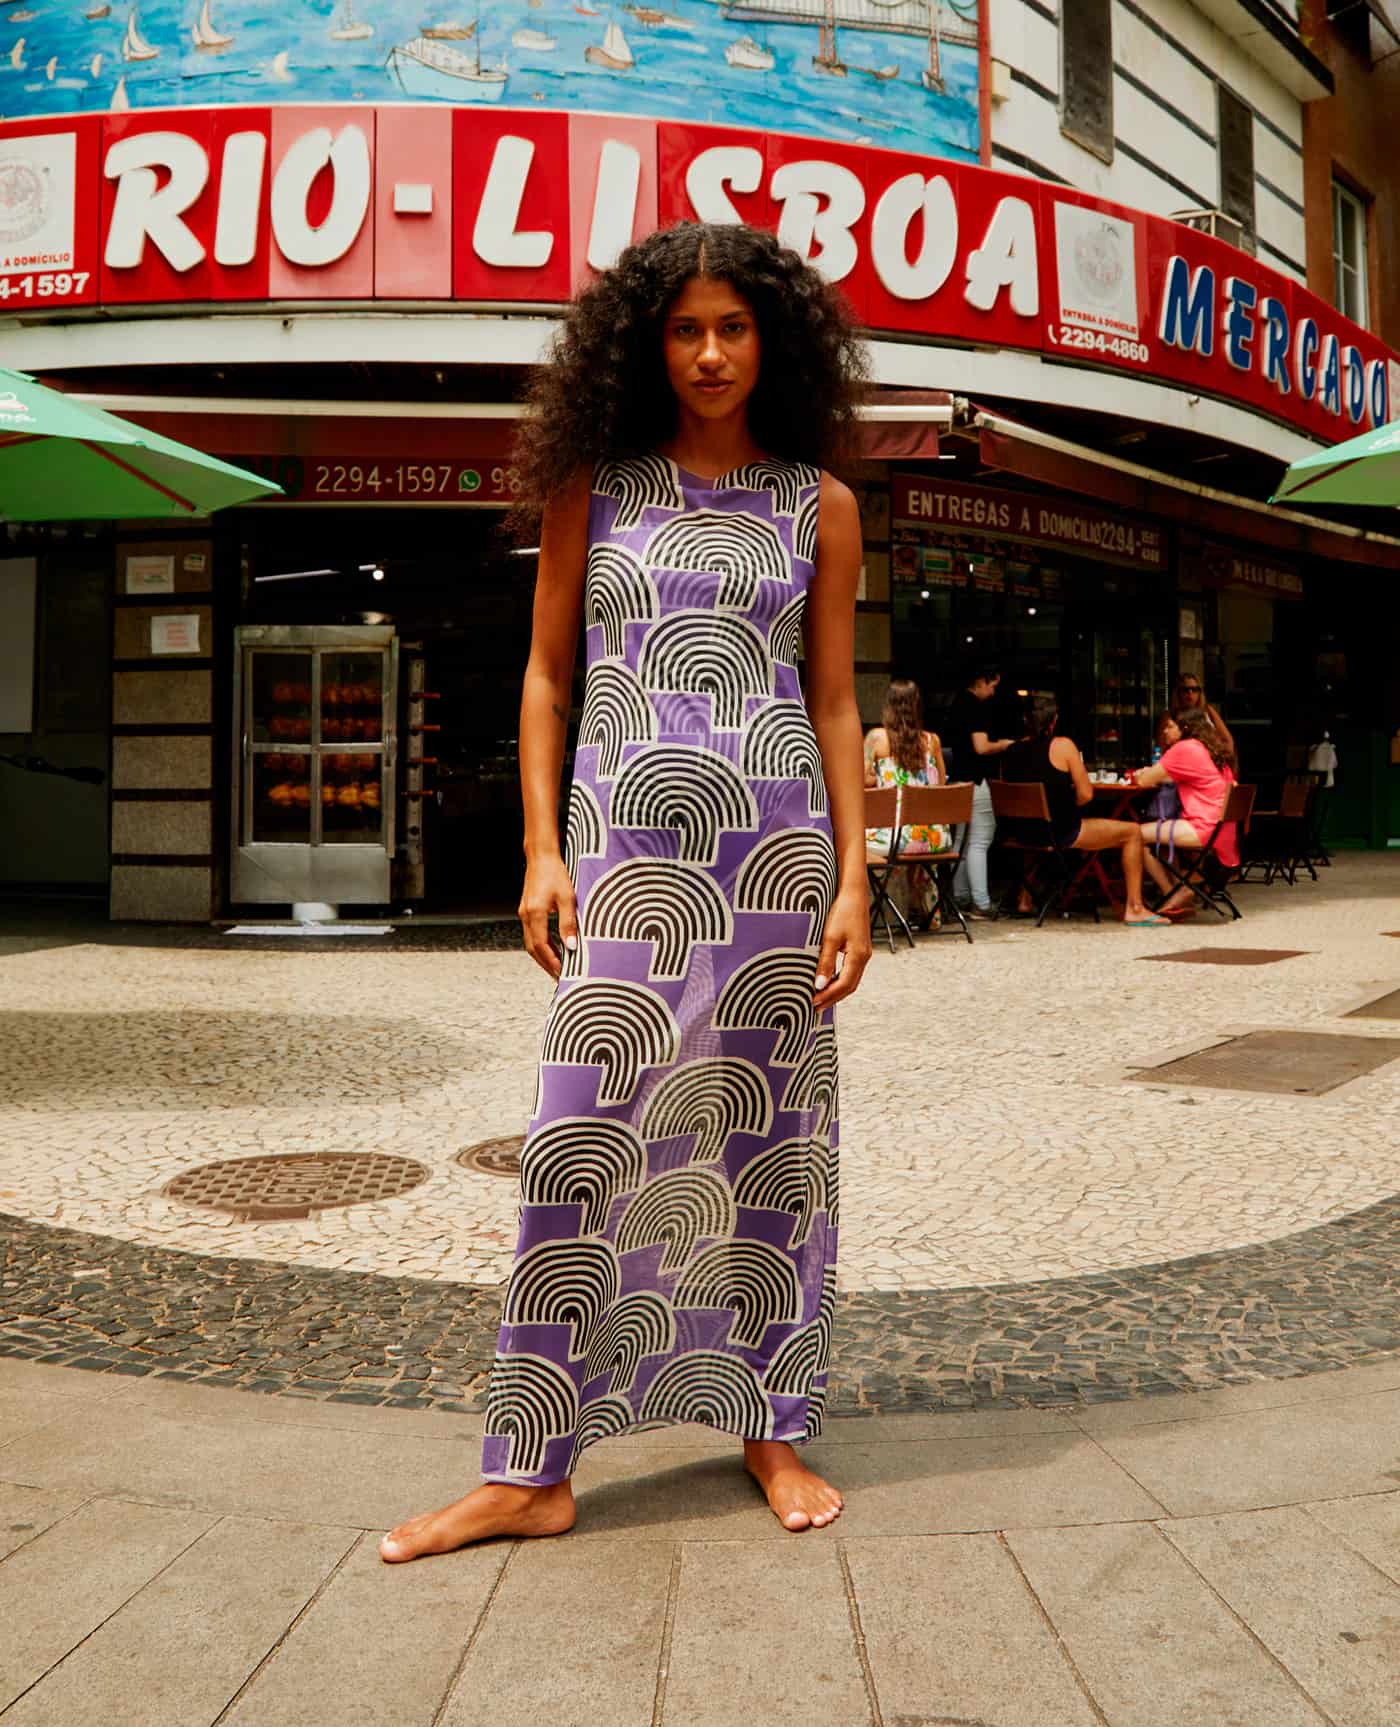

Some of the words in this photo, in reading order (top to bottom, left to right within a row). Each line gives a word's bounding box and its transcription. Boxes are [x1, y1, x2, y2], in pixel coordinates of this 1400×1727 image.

[104, 124, 370, 272] RIO
[472, 135, 1038, 316] LISBOA
[4, 256, 11, 267] A
[1059, 326, 1150, 363] 2294-4860
[1158, 255, 1387, 428] MERCADO
[315, 465, 452, 493] 2294-1597
[907, 489, 1010, 527] ENTREGAS
[1020, 508, 1031, 532] A
